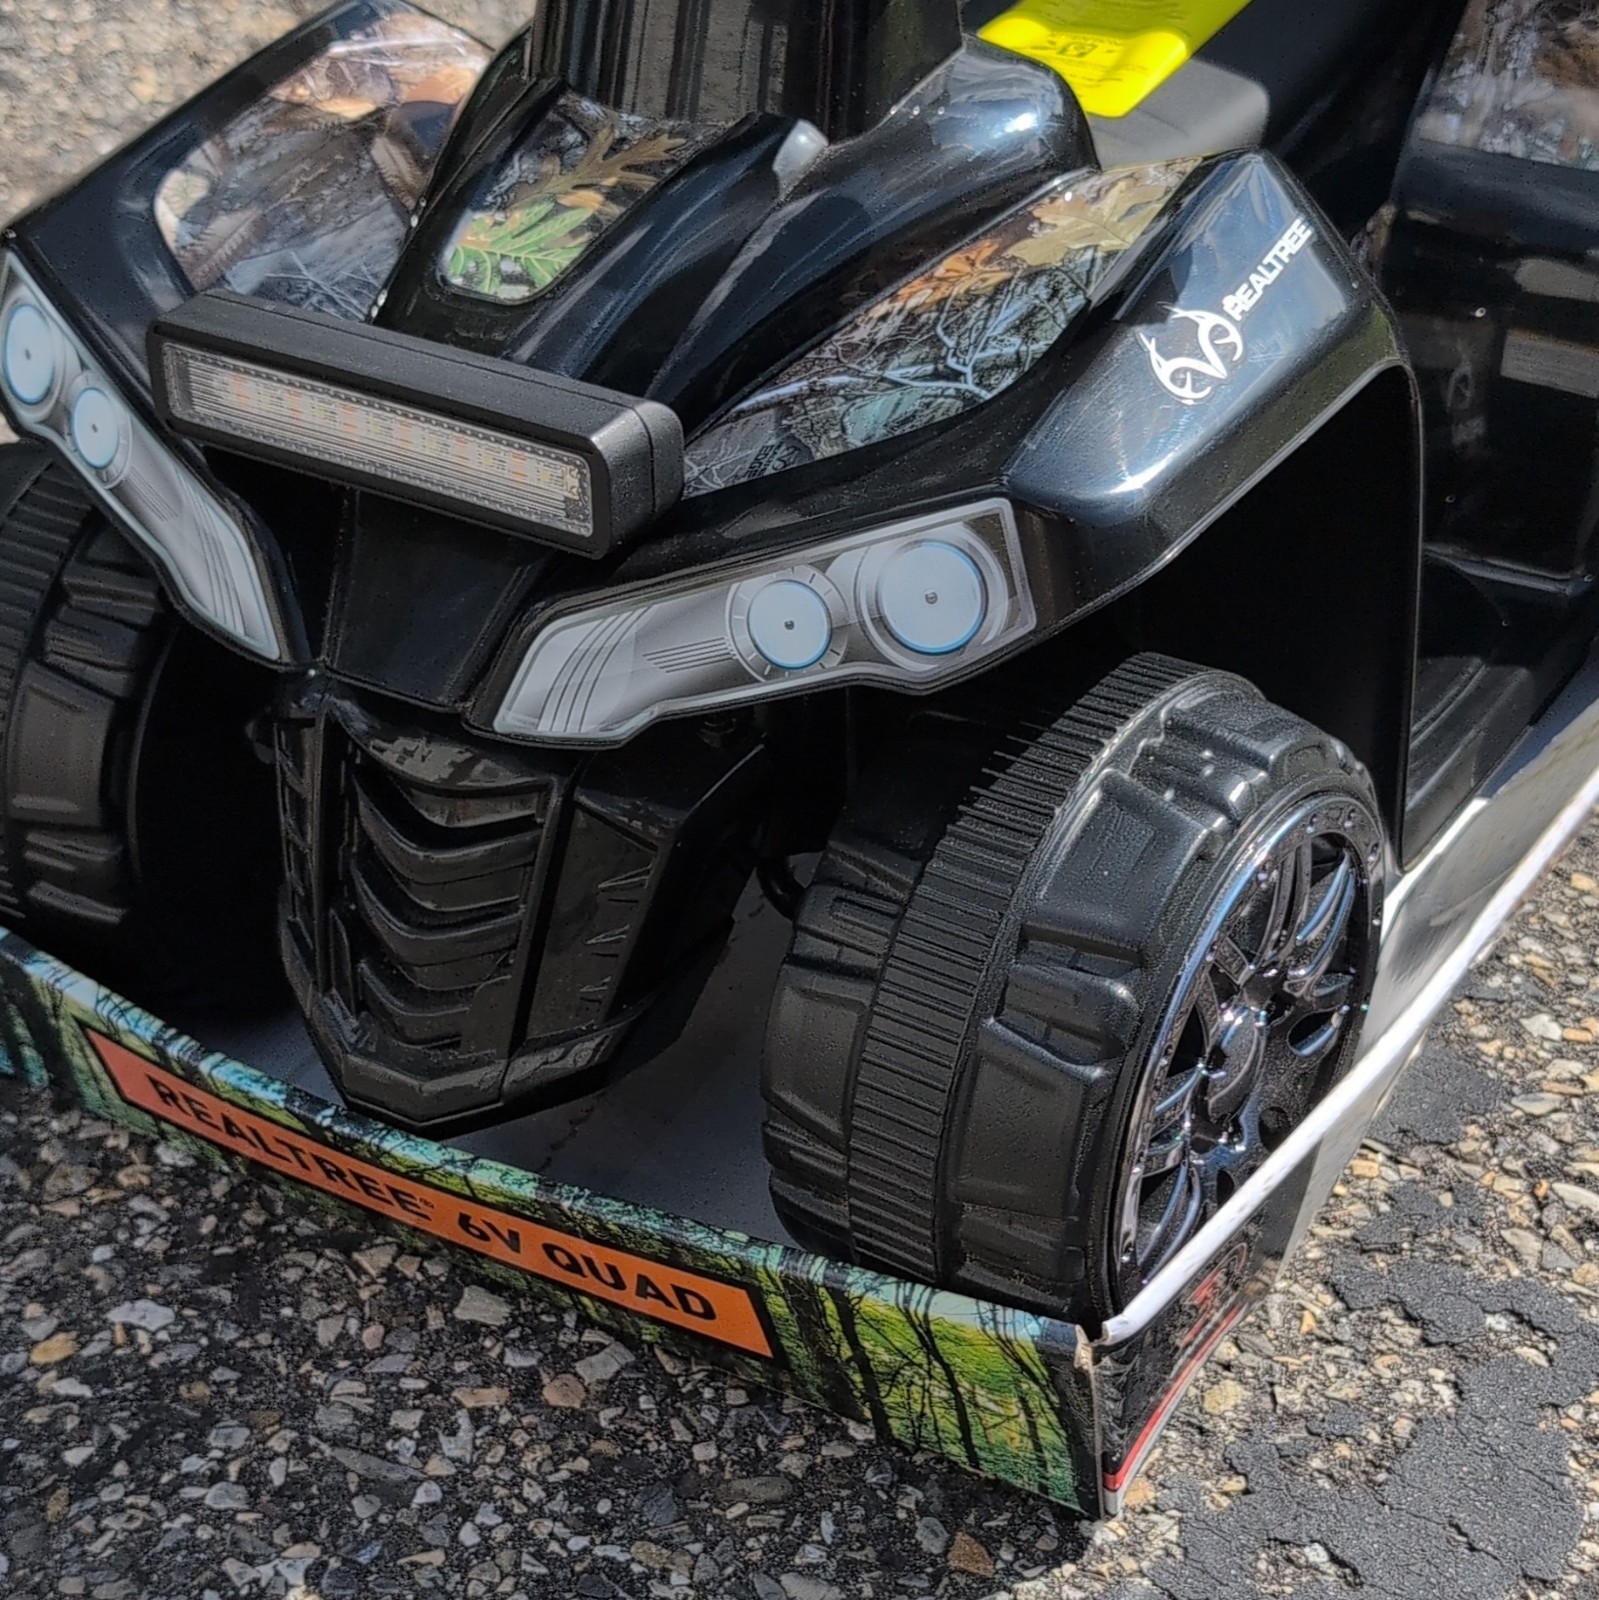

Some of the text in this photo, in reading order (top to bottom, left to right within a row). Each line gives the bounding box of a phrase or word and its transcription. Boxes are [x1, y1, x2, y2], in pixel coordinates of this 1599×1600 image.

[1222, 217, 1313, 321] REALTREE
[458, 1212, 521, 1254] 6V
[541, 1242, 717, 1321] QUAD
